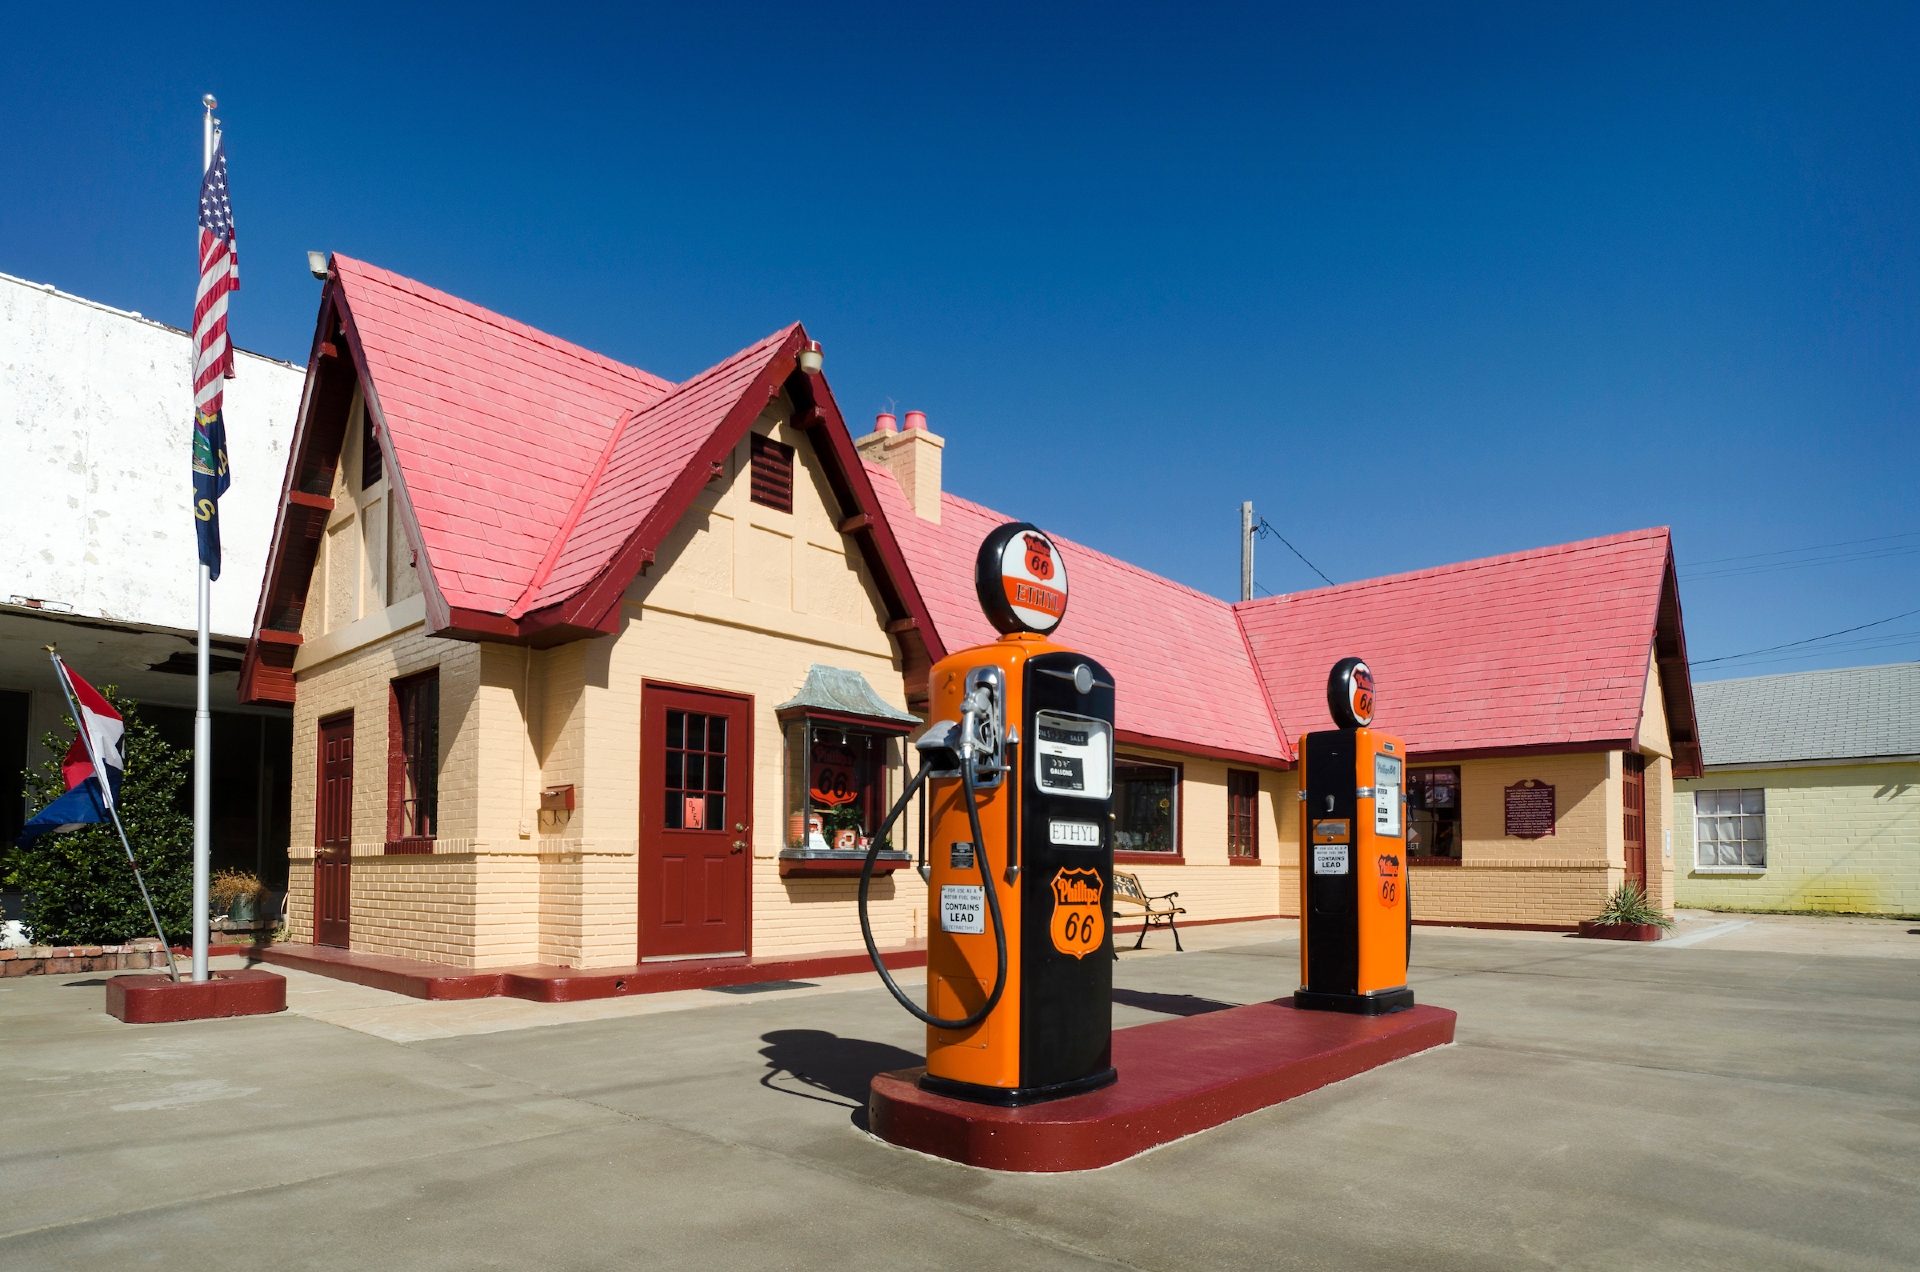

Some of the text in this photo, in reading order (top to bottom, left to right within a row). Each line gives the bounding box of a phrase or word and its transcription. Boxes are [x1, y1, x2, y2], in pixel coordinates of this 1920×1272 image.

[1031, 555, 1049, 576] 66
[1015, 583, 1059, 612] ETHYL
[1360, 693, 1373, 715] 66
[1070, 734, 1085, 742] SALE
[818, 767, 848, 799] 66
[1050, 767, 1074, 777] GALLONS
[688, 800, 700, 827] OPEN
[1051, 823, 1097, 842] ETHYL
[1057, 878, 1098, 909] Phillips
[1382, 880, 1396, 902] 66
[945, 902, 980, 911] CONTAINS
[950, 912, 974, 923] LEAD
[1065, 912, 1095, 944] 66
